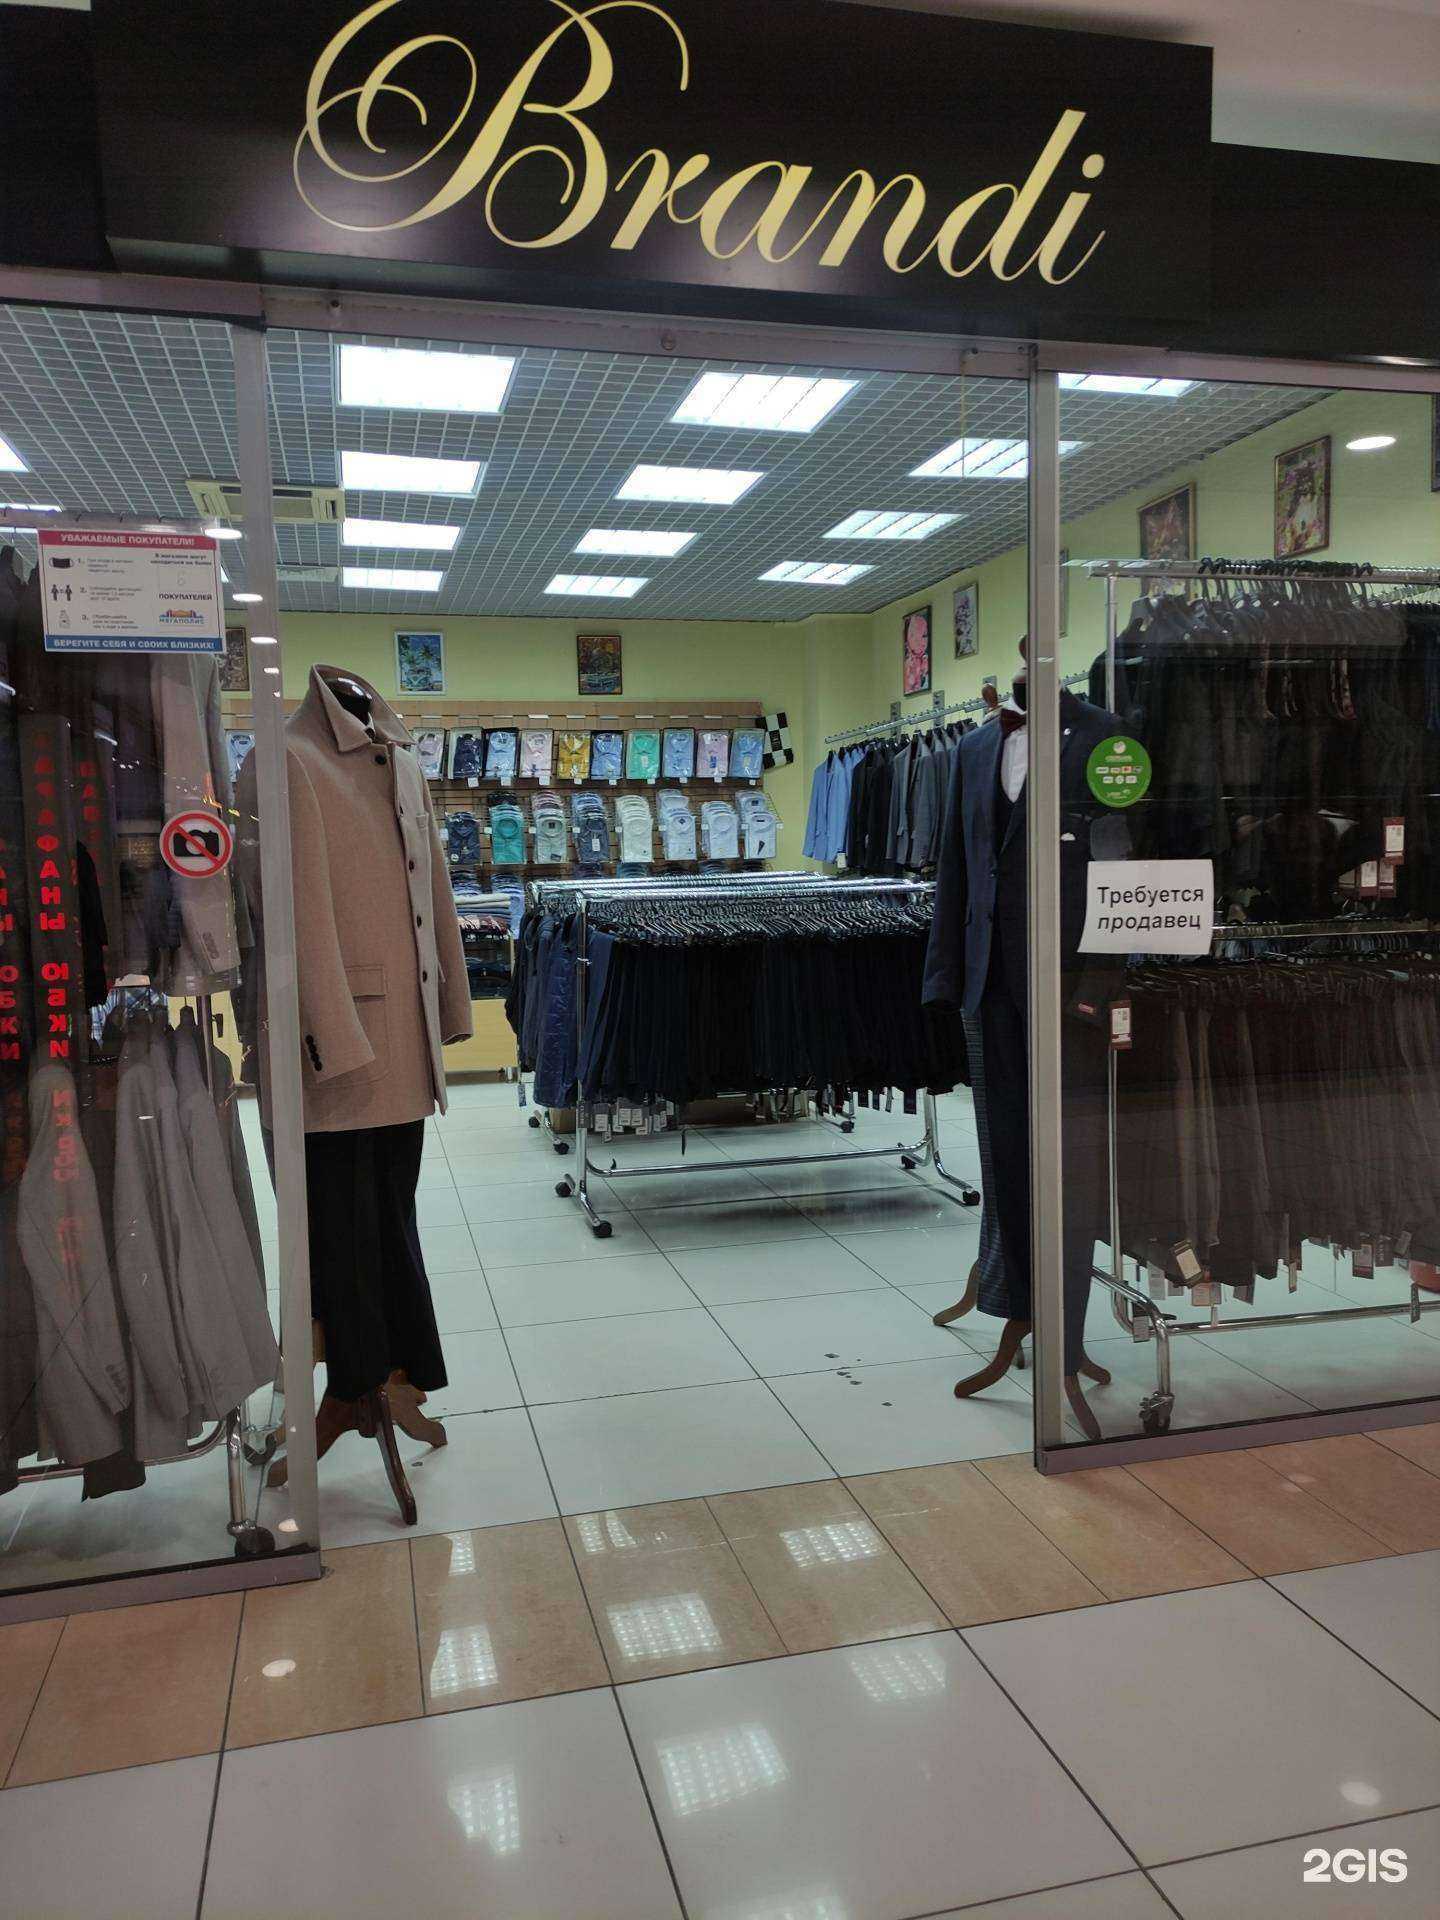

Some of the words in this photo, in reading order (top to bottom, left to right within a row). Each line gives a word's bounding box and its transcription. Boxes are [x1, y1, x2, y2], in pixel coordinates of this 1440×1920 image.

[293, 0, 1106, 285] Brandi
[60, 533, 127, 544] УВАЖАЕМЫЕ
[128, 535, 195, 546] ПОКУПАТЕЛИ!
[159, 592, 213, 601] ПОКУПАТЕЛЕЙ
[53, 639, 100, 648] БЕРЕГИТЕ
[102, 640, 127, 648] СЕБЯ
[137, 641, 168, 649] СВОИХ
[170, 642, 215, 650] БЛИЗКИХ!
[1097, 885, 1204, 908] Требуется
[1097, 913, 1201, 933] продавец
